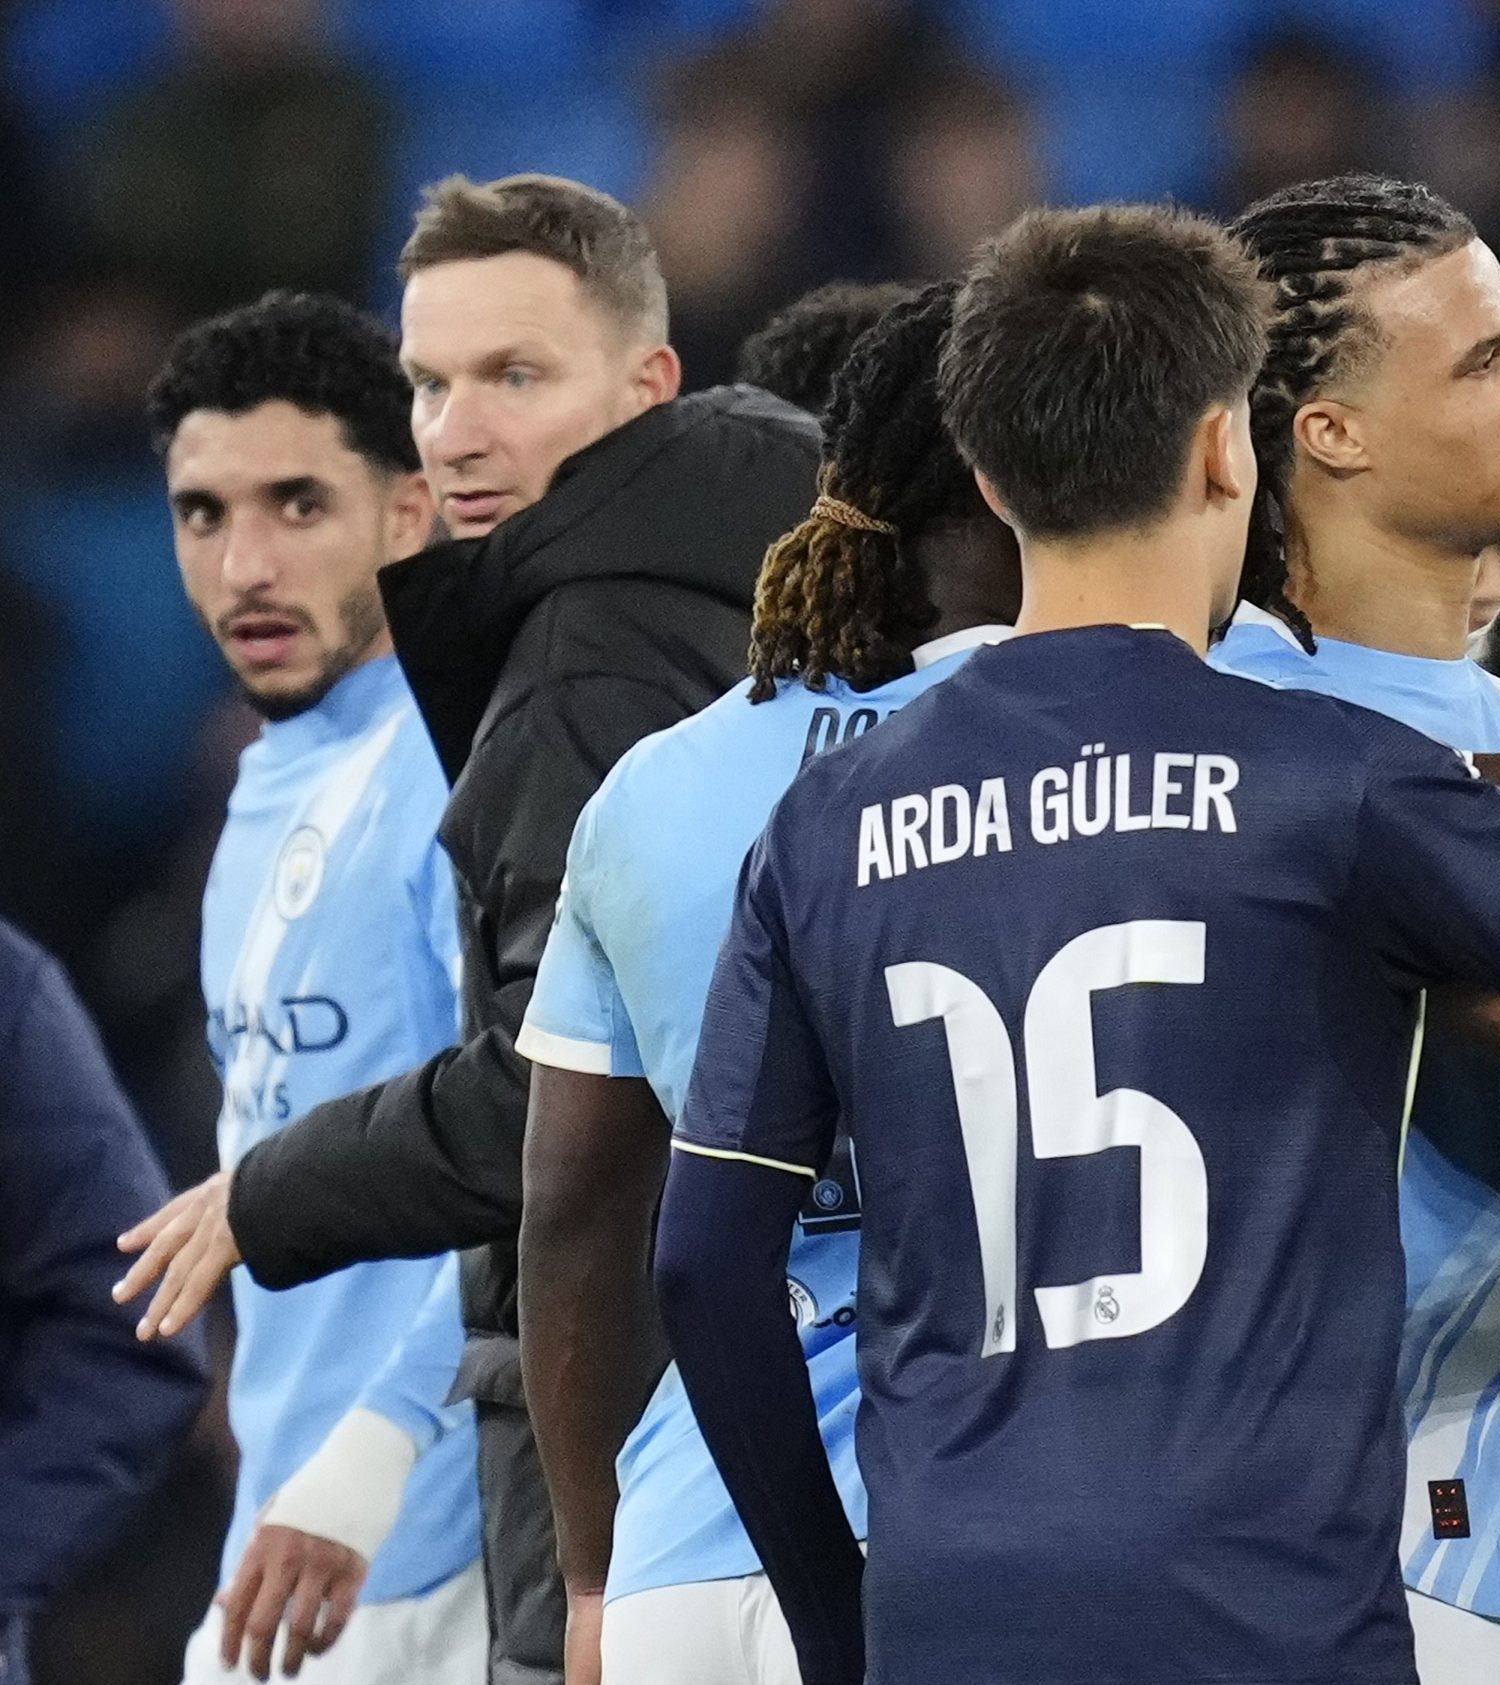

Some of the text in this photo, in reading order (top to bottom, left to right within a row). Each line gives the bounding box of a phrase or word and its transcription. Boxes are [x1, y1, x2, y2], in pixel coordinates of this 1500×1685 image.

[799, 707, 900, 768] DO
[857, 742, 1240, 887] ARDA GÜLER
[884, 920, 1208, 1358] 15
